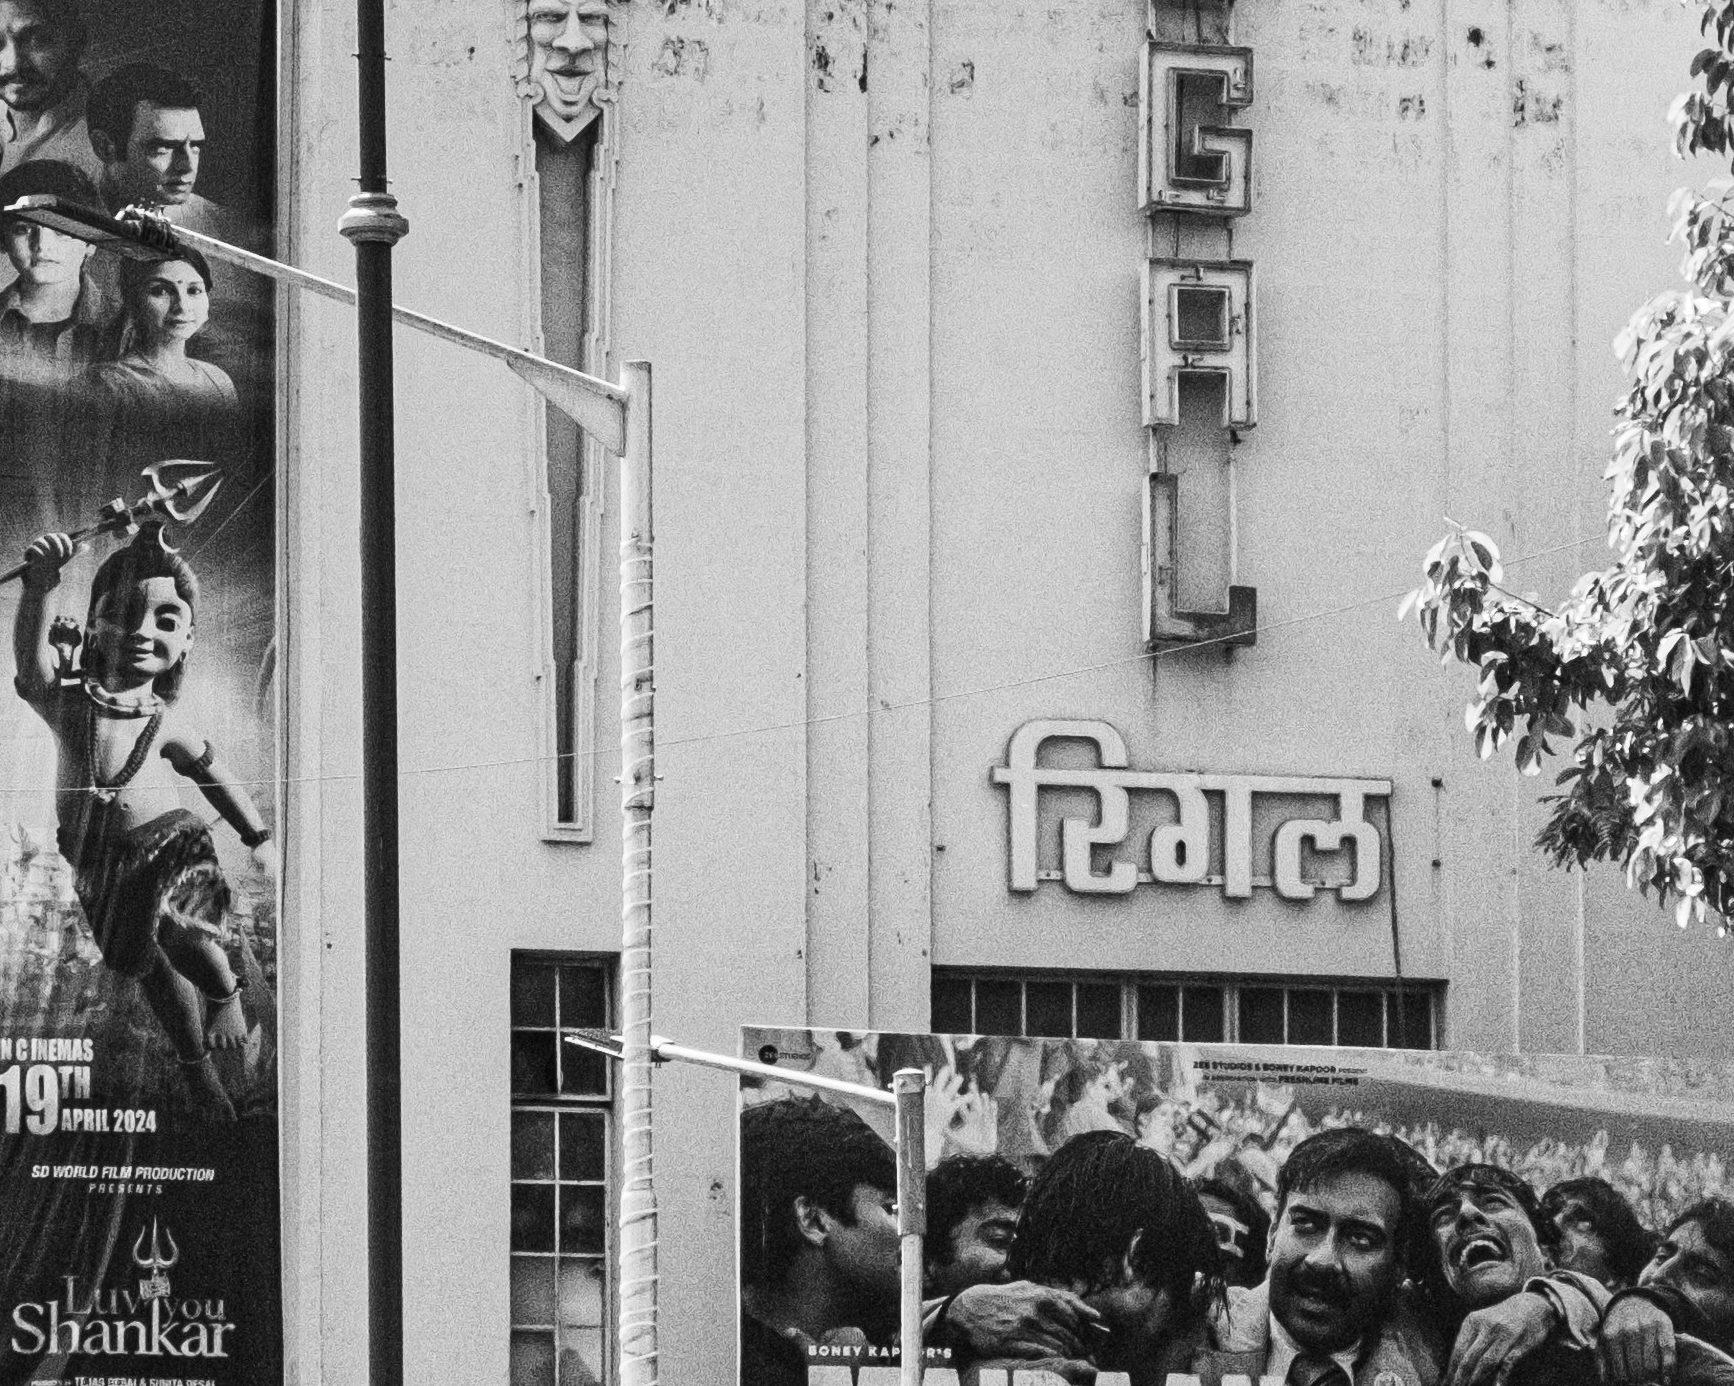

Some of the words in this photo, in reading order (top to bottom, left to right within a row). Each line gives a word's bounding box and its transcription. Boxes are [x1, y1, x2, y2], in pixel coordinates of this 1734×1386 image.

[989, 718, 1394, 901] रिगल
[61, 1108, 109, 1132] APRIL
[113, 1109, 157, 1133] 2024
[53, 1165, 98, 1179] WORLD
[101, 1165, 132, 1180] FILM
[134, 1166, 215, 1181] PRODUCTION
[88, 1183, 163, 1195] PRESENTS
[61, 1275, 141, 1314] Luv
[162, 1298, 226, 1329] you
[11, 1300, 236, 1357] Shankar
[808, 1346, 862, 1356] BONEY
[869, 1346, 952, 1359] KAPR'S
